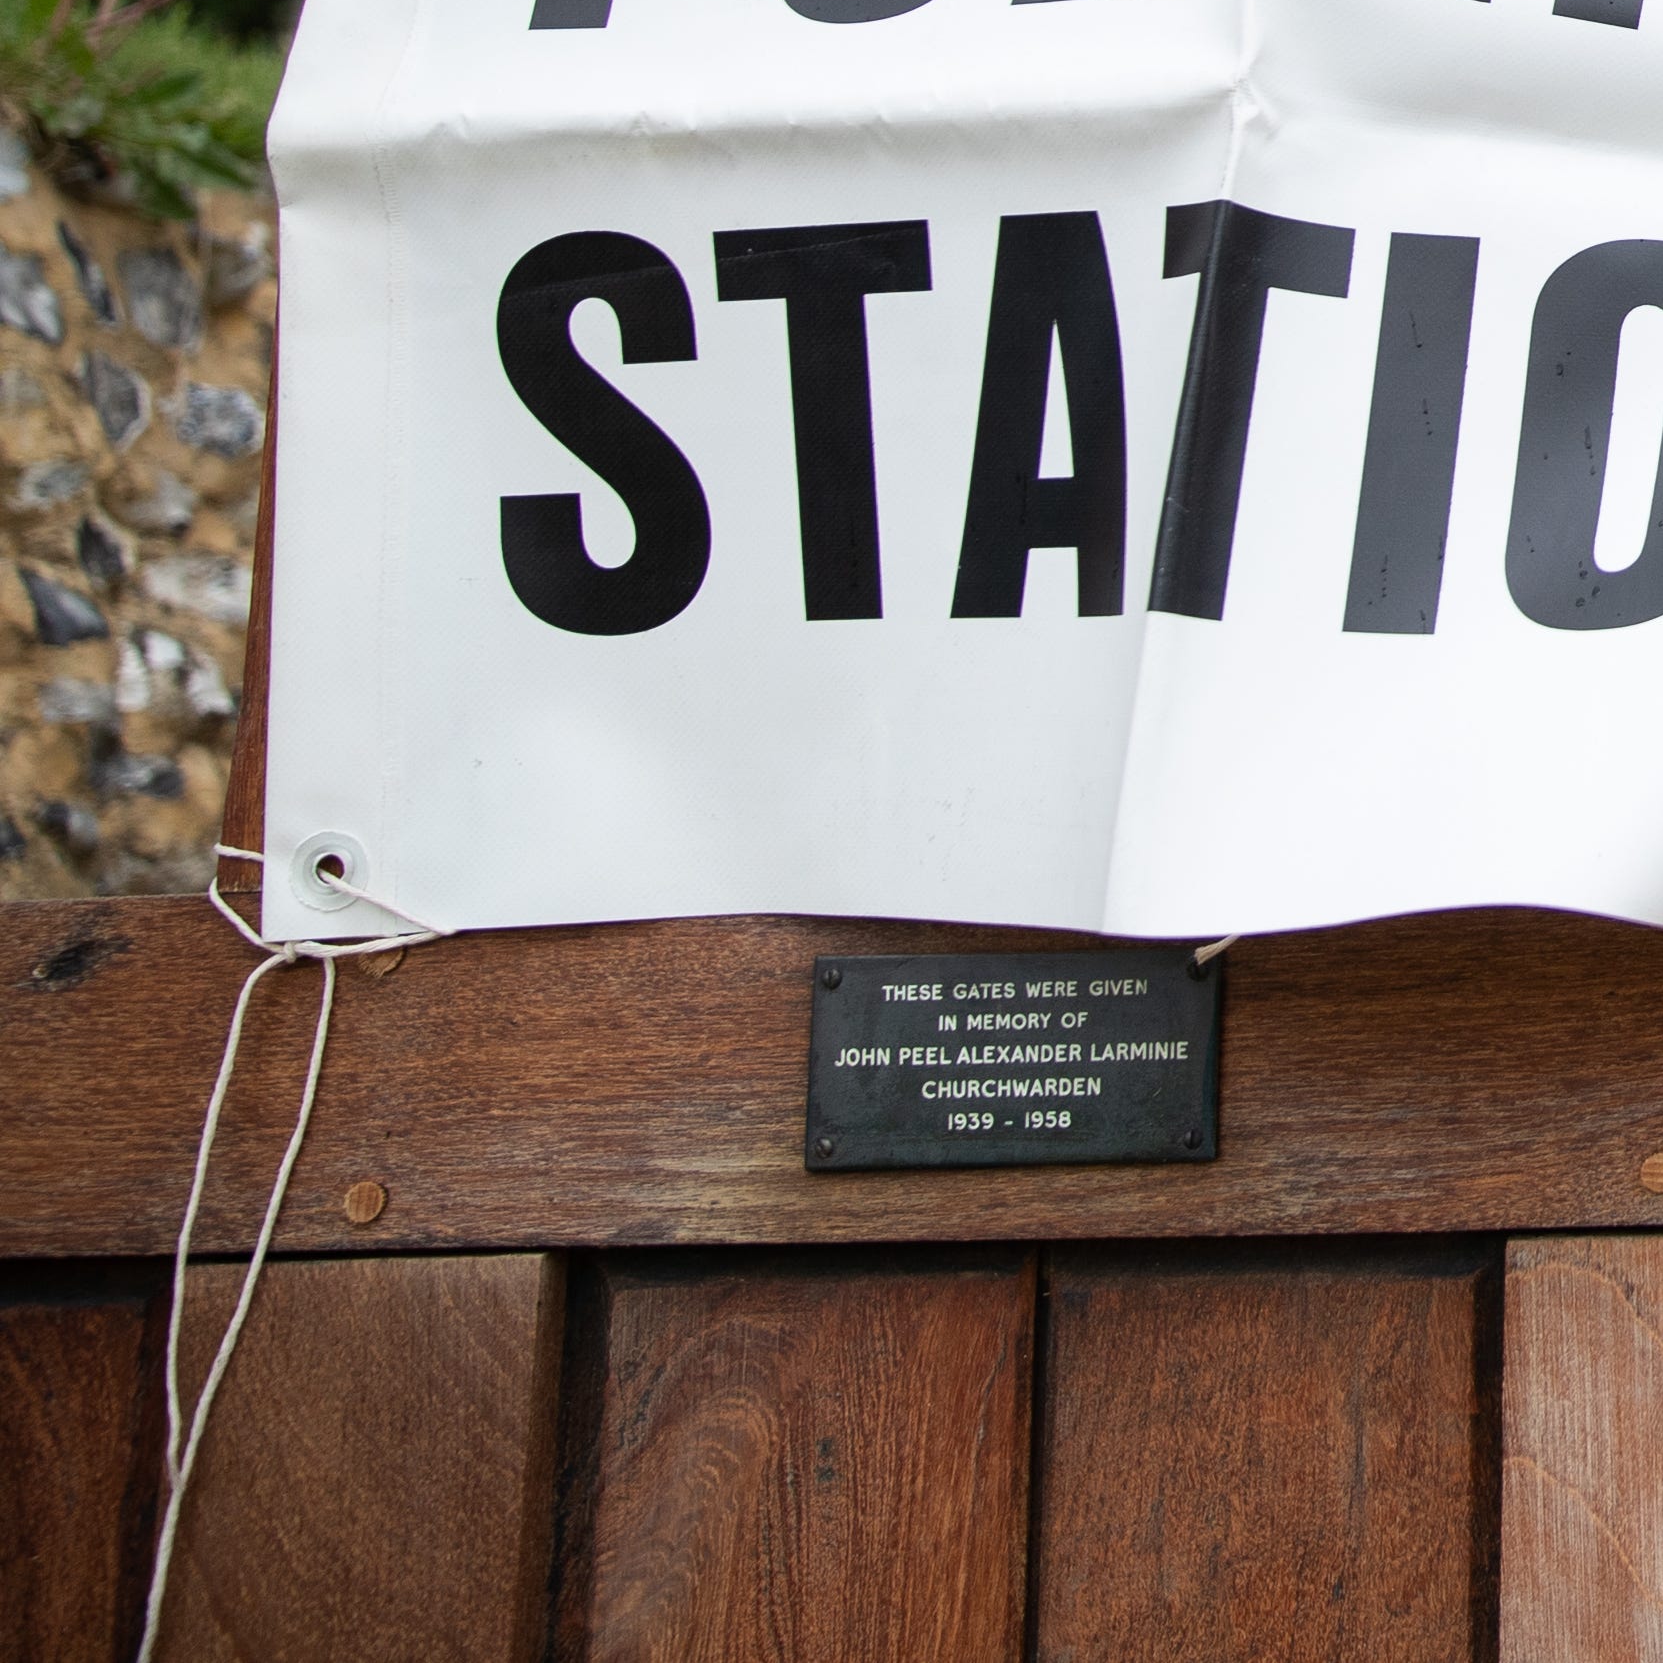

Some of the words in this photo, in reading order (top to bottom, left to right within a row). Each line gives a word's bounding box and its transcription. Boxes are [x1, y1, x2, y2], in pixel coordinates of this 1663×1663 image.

[882, 984, 943, 1002] THESE
[953, 983, 1015, 1000] GATES
[1026, 981, 1078, 998] WERE
[1089, 980, 1148, 996] GIVEN
[938, 1015, 957, 1031] IN
[967, 1013, 1051, 1030] MEMORY
[1061, 1012, 1088, 1028] OF
[835, 1048, 890, 1066] JOHN
[899, 1047, 951, 1065] PEEL
[957, 1044, 1082, 1064] ALEXANDER
[1091, 1042, 1189, 1061] LARMINIE
[922, 1078, 1101, 1099] CHURCHWARDEN
[947, 1113, 994, 1130] 1939
[1025, 1111, 1072, 1128] 1958
